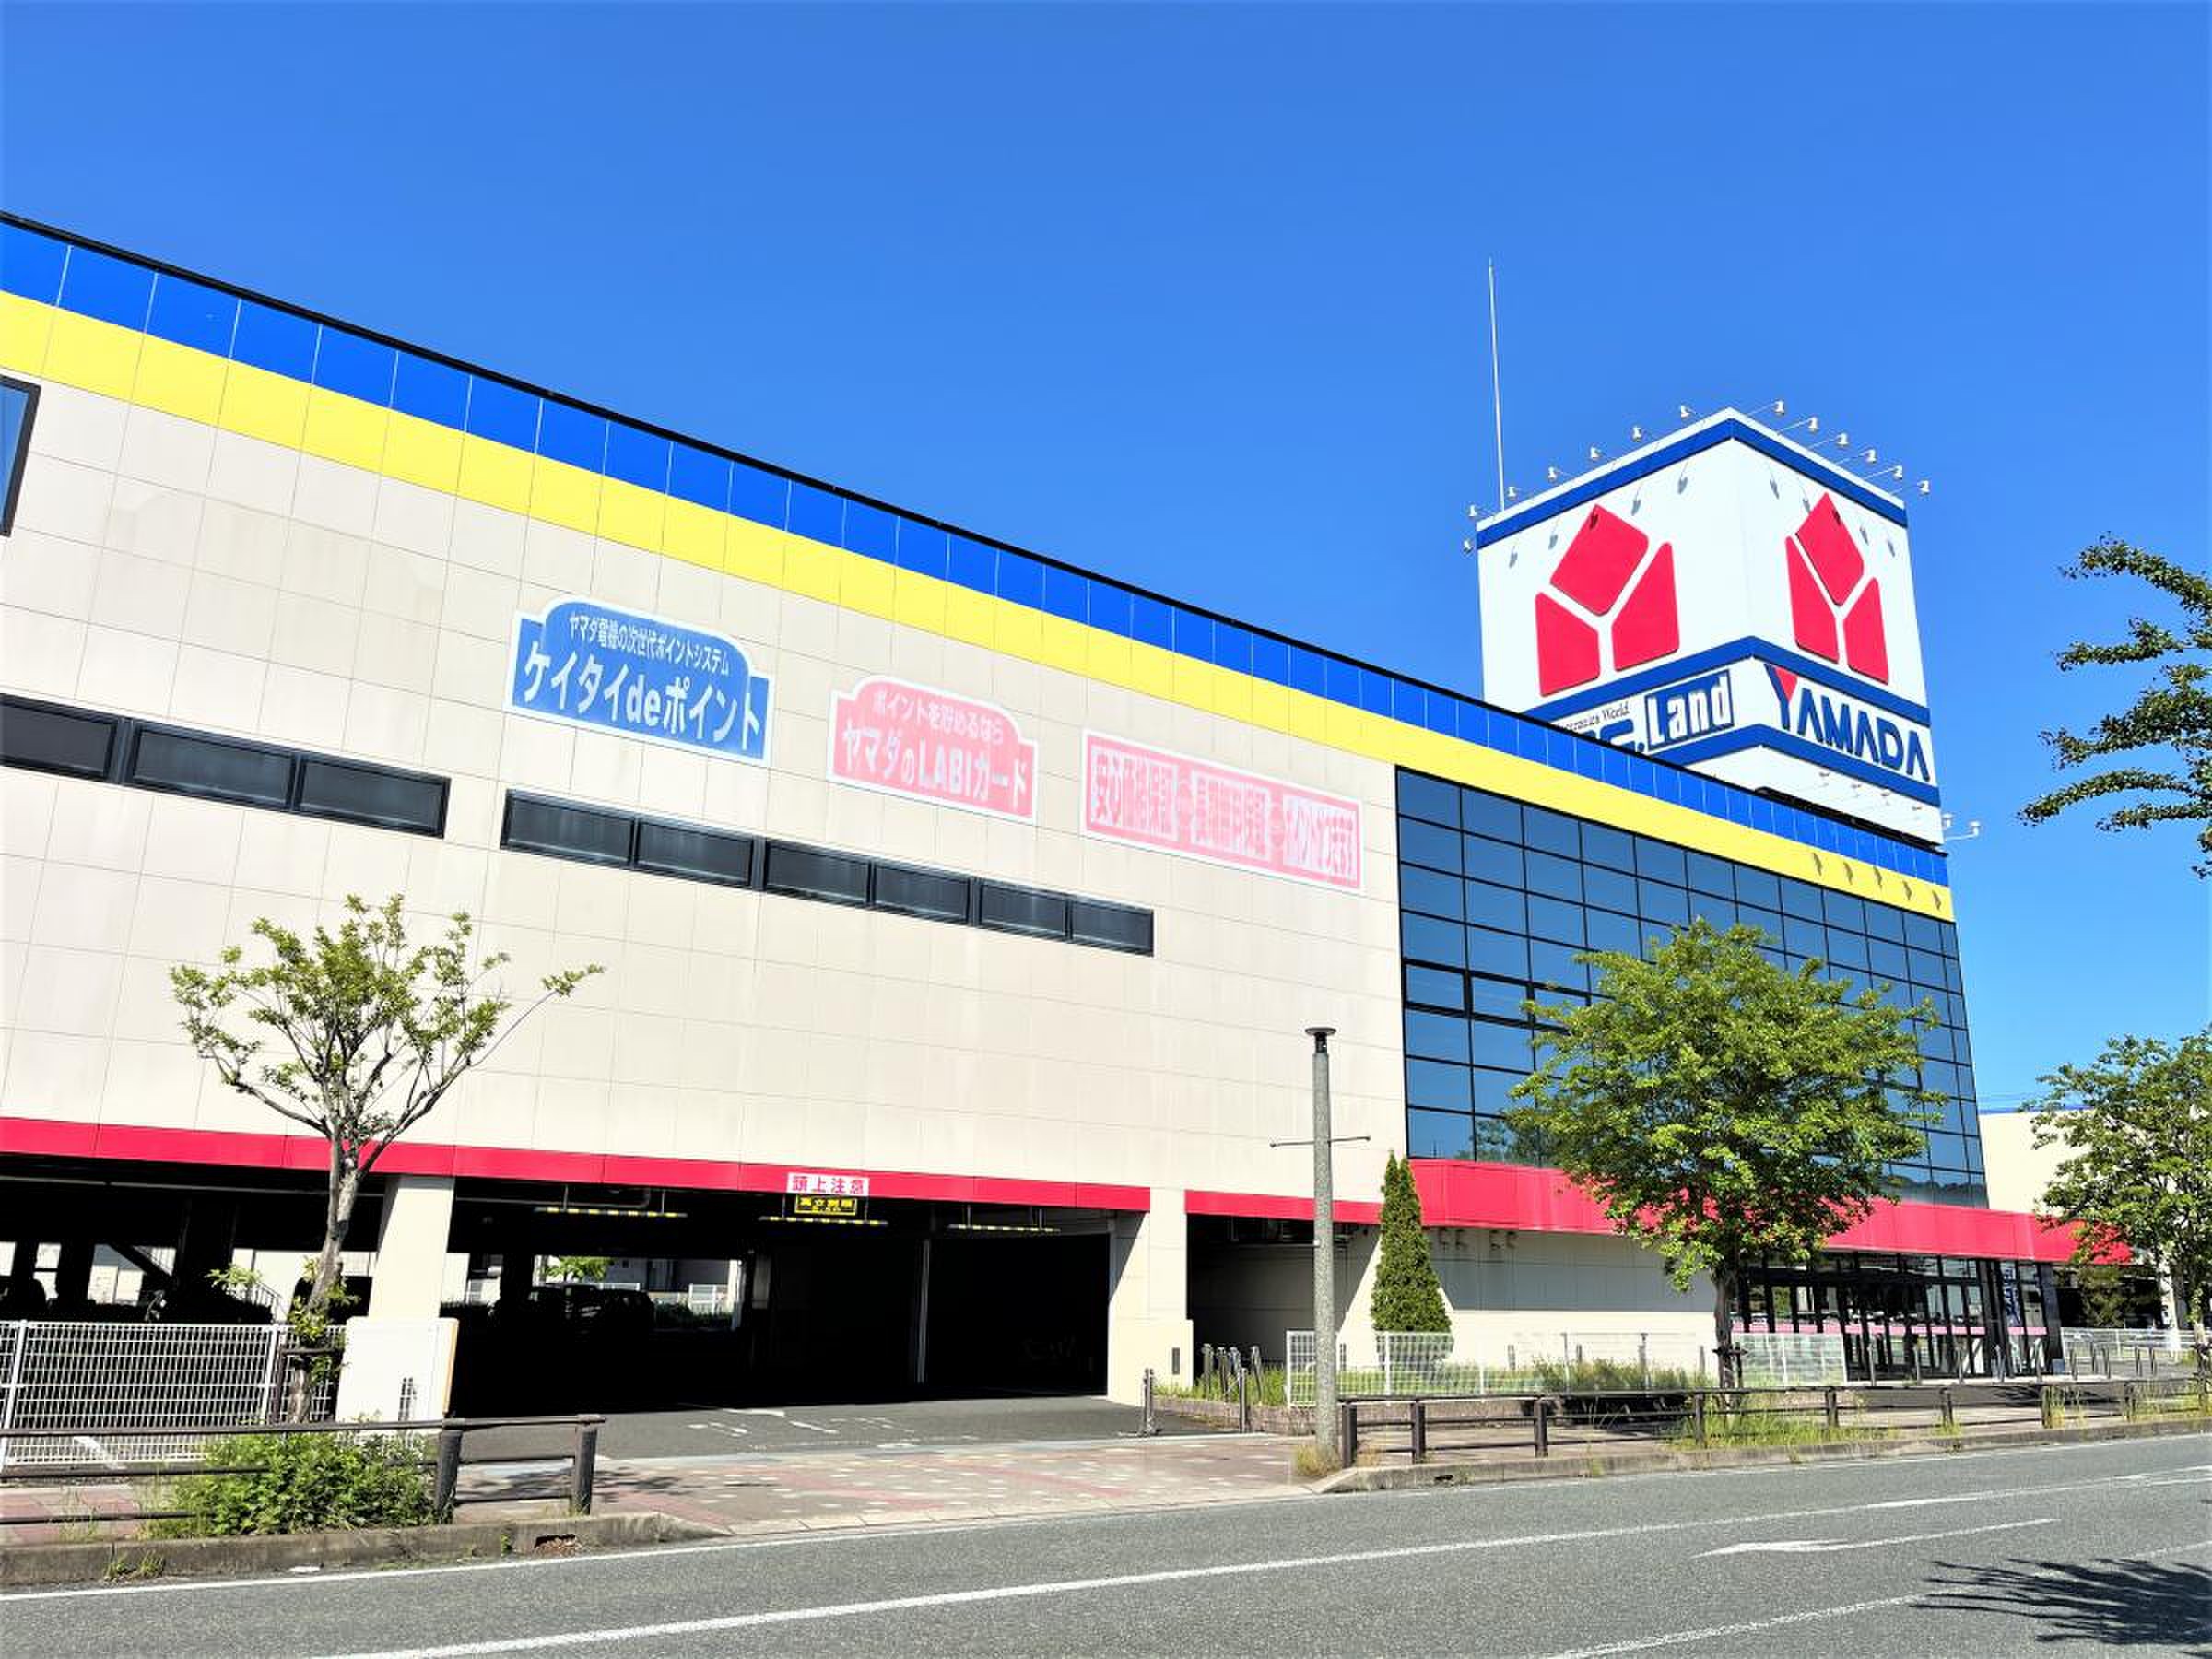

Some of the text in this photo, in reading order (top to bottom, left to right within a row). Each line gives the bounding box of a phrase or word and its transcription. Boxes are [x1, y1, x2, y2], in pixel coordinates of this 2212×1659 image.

[524, 641, 760, 751] ケイタイdeポイント
[1764, 663, 1930, 782] YAMADA
[843, 718, 1028, 809] ヤマダのLABIカード
[792, 1175, 865, 1195] 頭上注意
